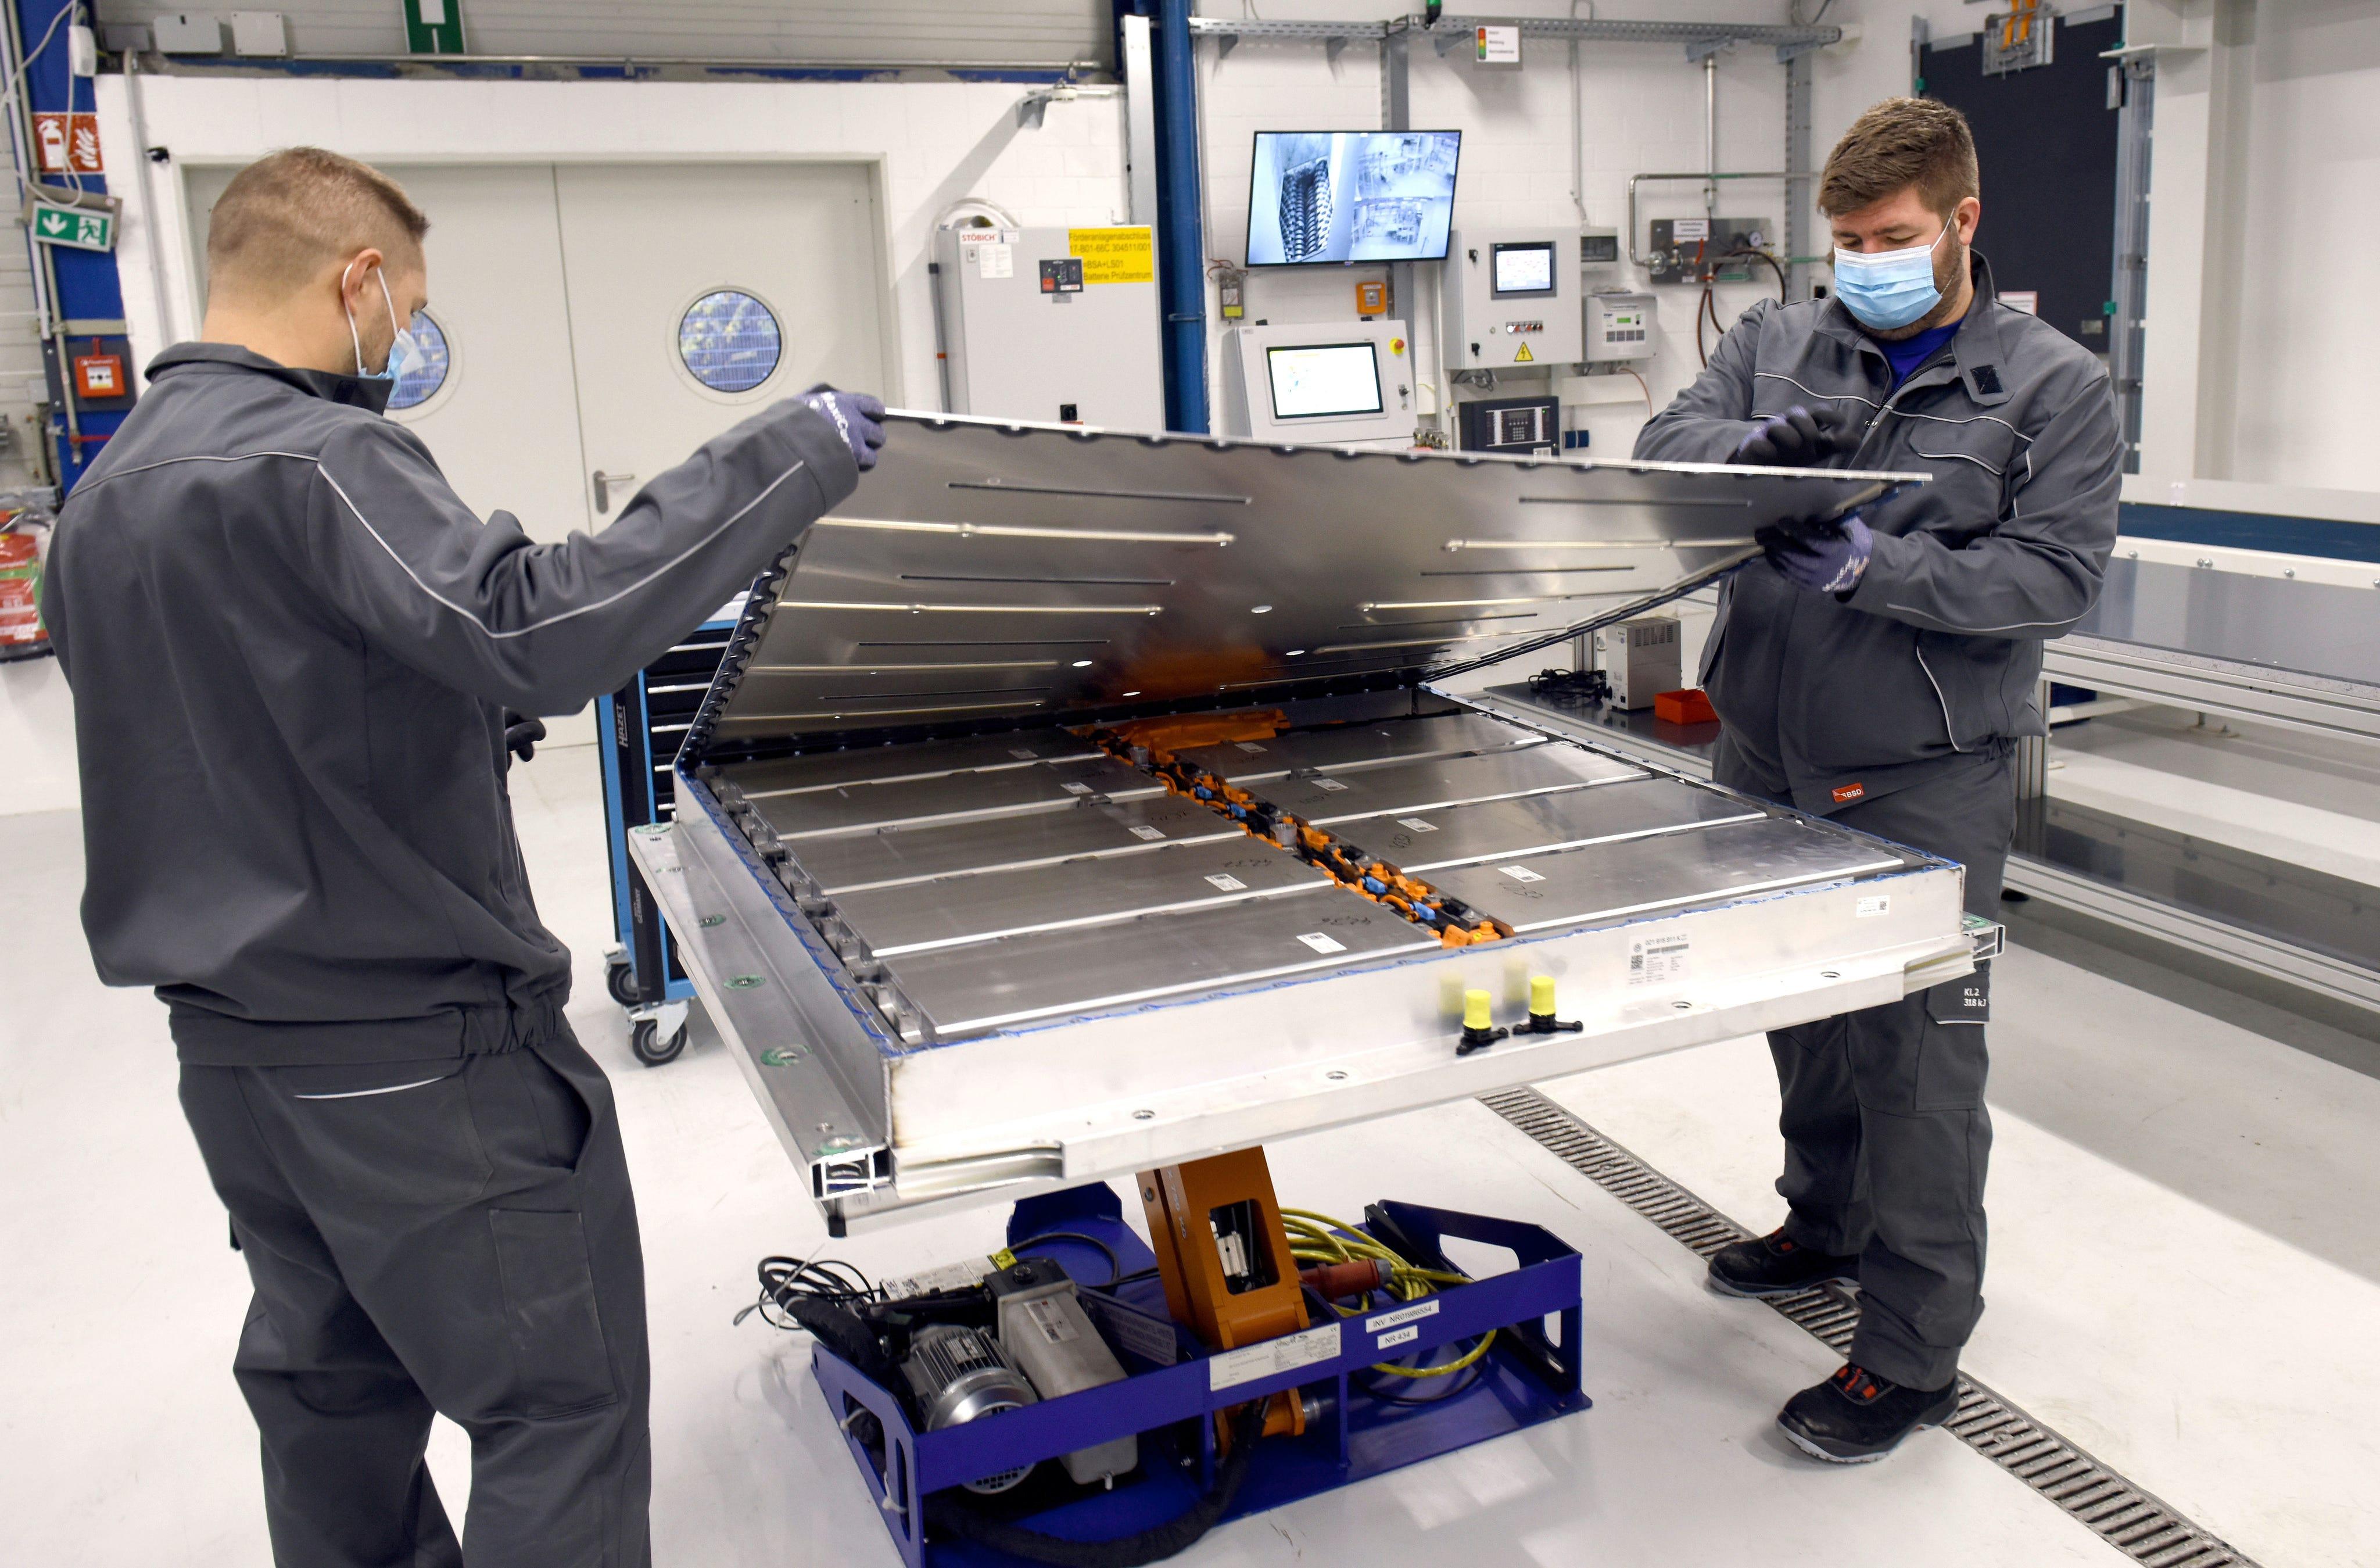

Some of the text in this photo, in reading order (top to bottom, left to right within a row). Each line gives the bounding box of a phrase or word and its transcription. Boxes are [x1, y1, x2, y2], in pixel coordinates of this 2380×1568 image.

[616, 703, 628, 748] HAZET
[1847, 789, 1862, 798] BSD
[1373, 1317, 1386, 1328] INV
[1385, 1335, 1396, 1344] NR
